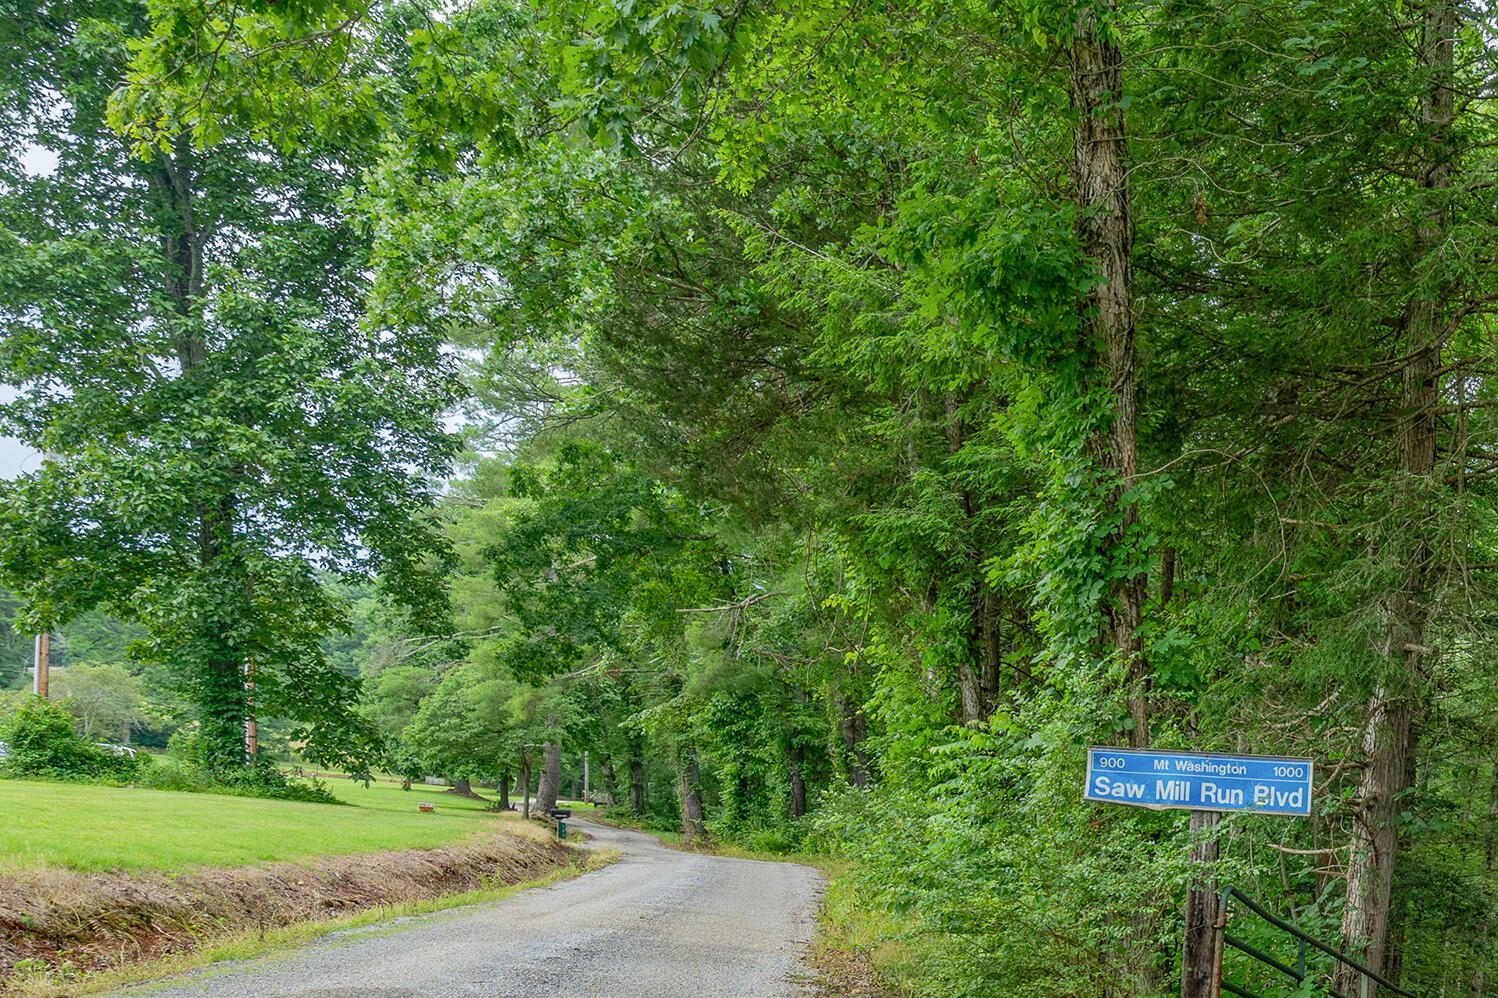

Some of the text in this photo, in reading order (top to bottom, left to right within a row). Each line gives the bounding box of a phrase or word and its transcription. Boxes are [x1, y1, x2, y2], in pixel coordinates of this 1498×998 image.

[1099, 757, 1304, 778] 900 Mt Washington 1000
[1094, 776, 1303, 808] Saw Mill Run Blvd
